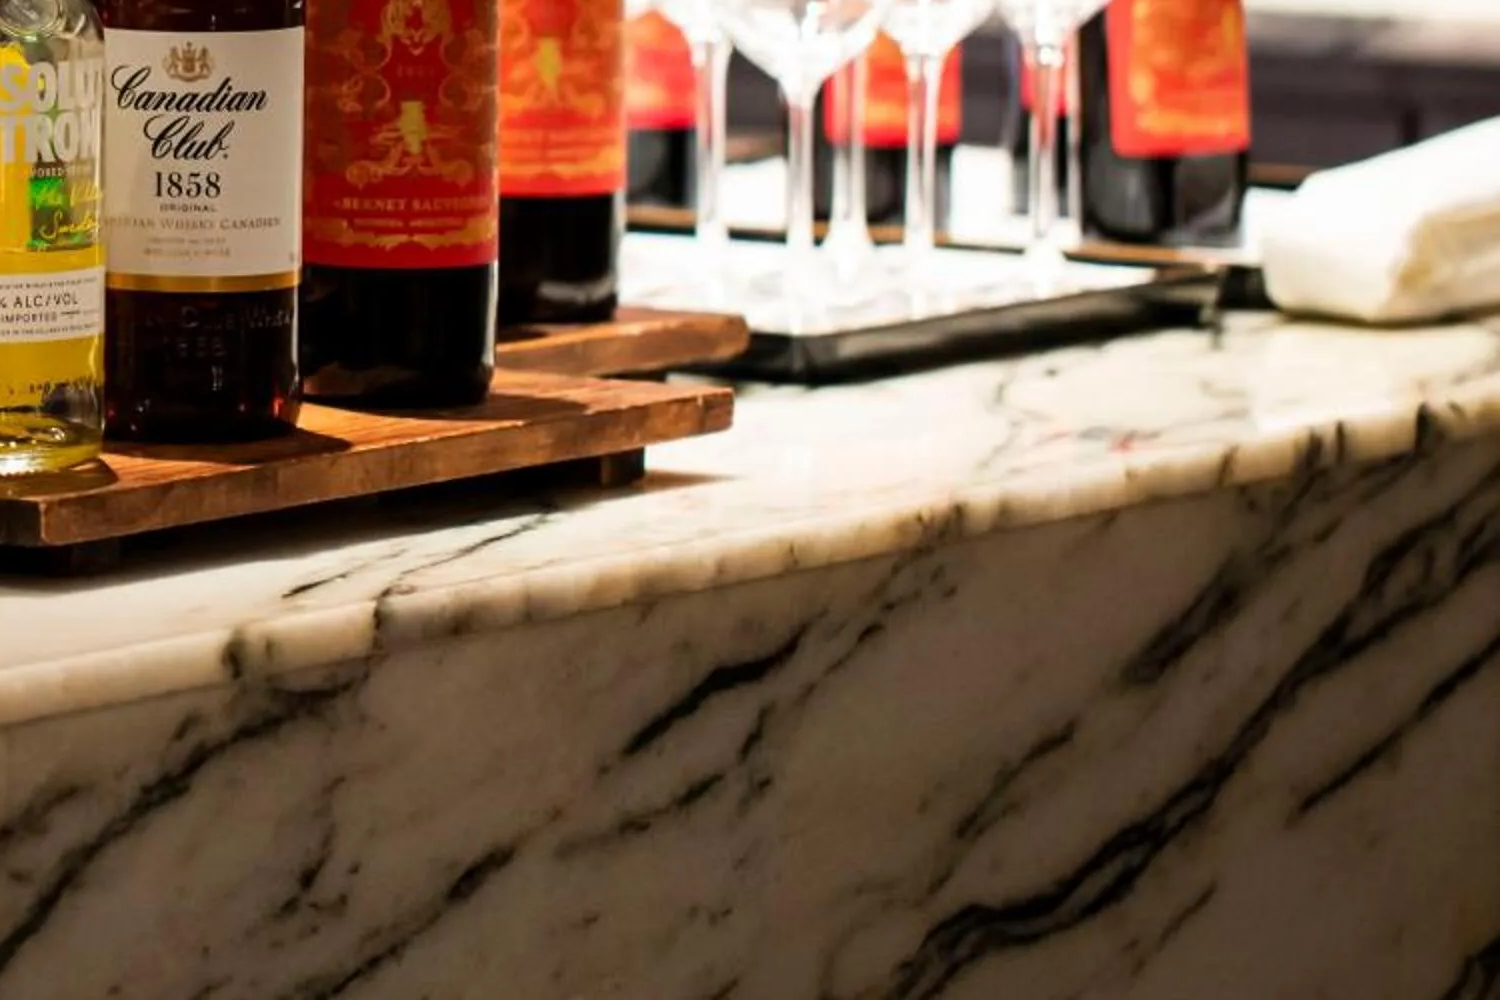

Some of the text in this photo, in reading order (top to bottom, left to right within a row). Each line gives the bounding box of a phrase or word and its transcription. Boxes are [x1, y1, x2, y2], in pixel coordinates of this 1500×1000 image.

[110, 64, 268, 113] Canadian
[154, 171, 222, 199] 1858
[159, 203, 218, 213] ORIGINAL
